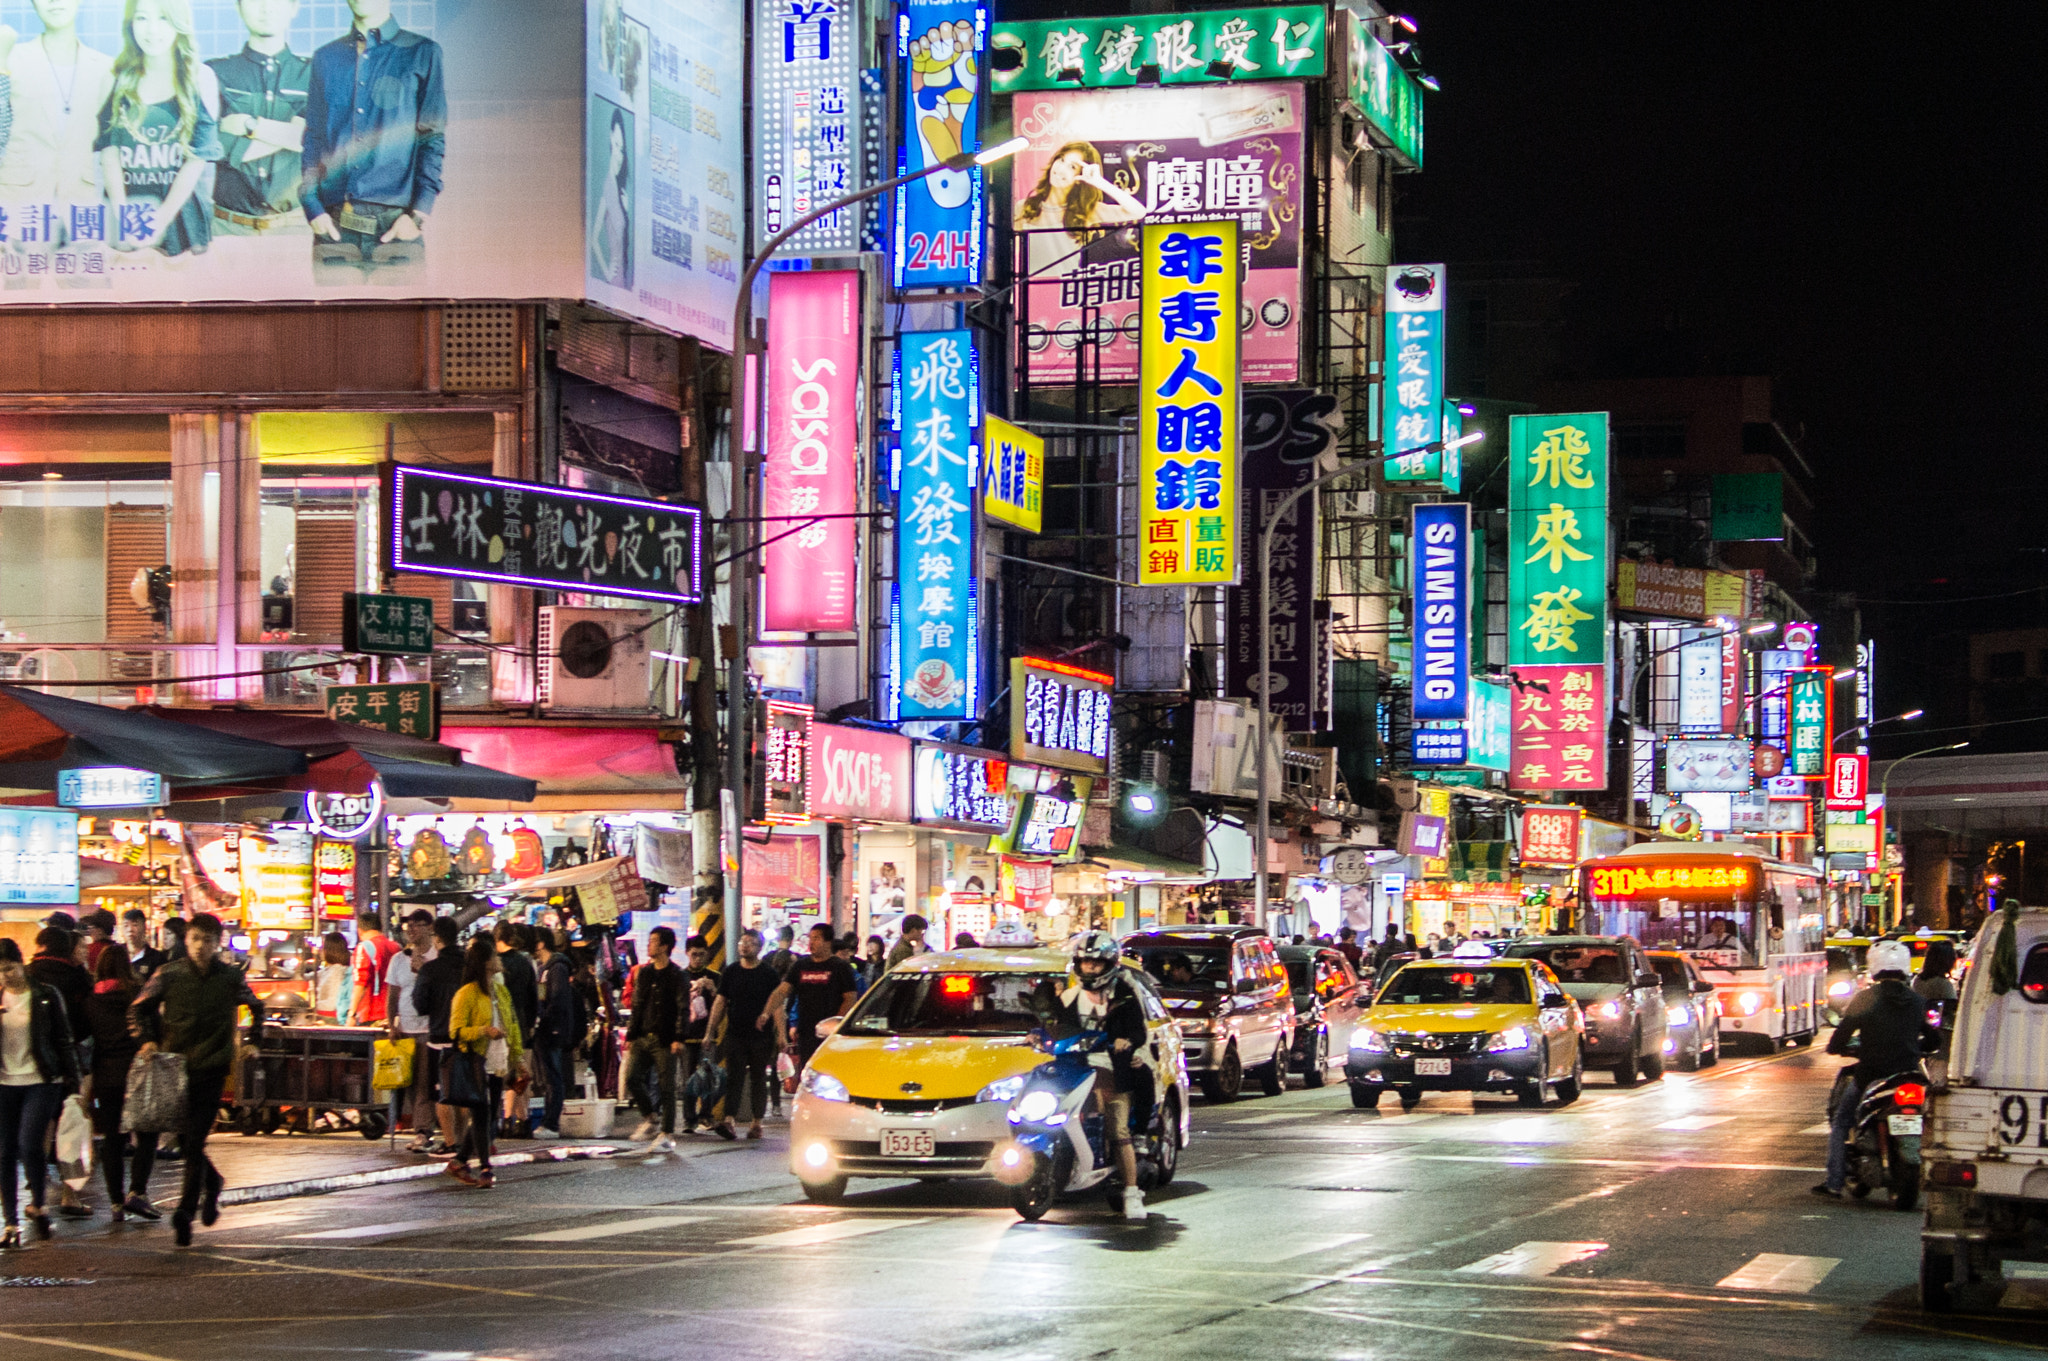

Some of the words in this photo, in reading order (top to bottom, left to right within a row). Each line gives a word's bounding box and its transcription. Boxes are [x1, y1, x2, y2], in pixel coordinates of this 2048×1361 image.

[1147, 155, 1264, 214] 魔瞳
[909, 231, 971, 270] 24H
[1156, 231, 1224, 510] 年青人眼鏡
[790, 487, 828, 549] 莎莎
[904, 336, 971, 650] 飛來發按摩館
[410, 490, 490, 560] 士林
[533, 499, 687, 585] 觀光夜市
[1148, 517, 1179, 575] 直銷
[1195, 516, 1226, 572] 量販
[1519, 425, 1596, 653] 飛來發
[365, 601, 426, 628] 文林路
[1424, 523, 1456, 700] SAMSUNG
[336, 691, 421, 717] 安平街
[1528, 814, 1562, 835] 888
[1593, 868, 1636, 896] 310
[884, 1135, 933, 1152] 153-E5
